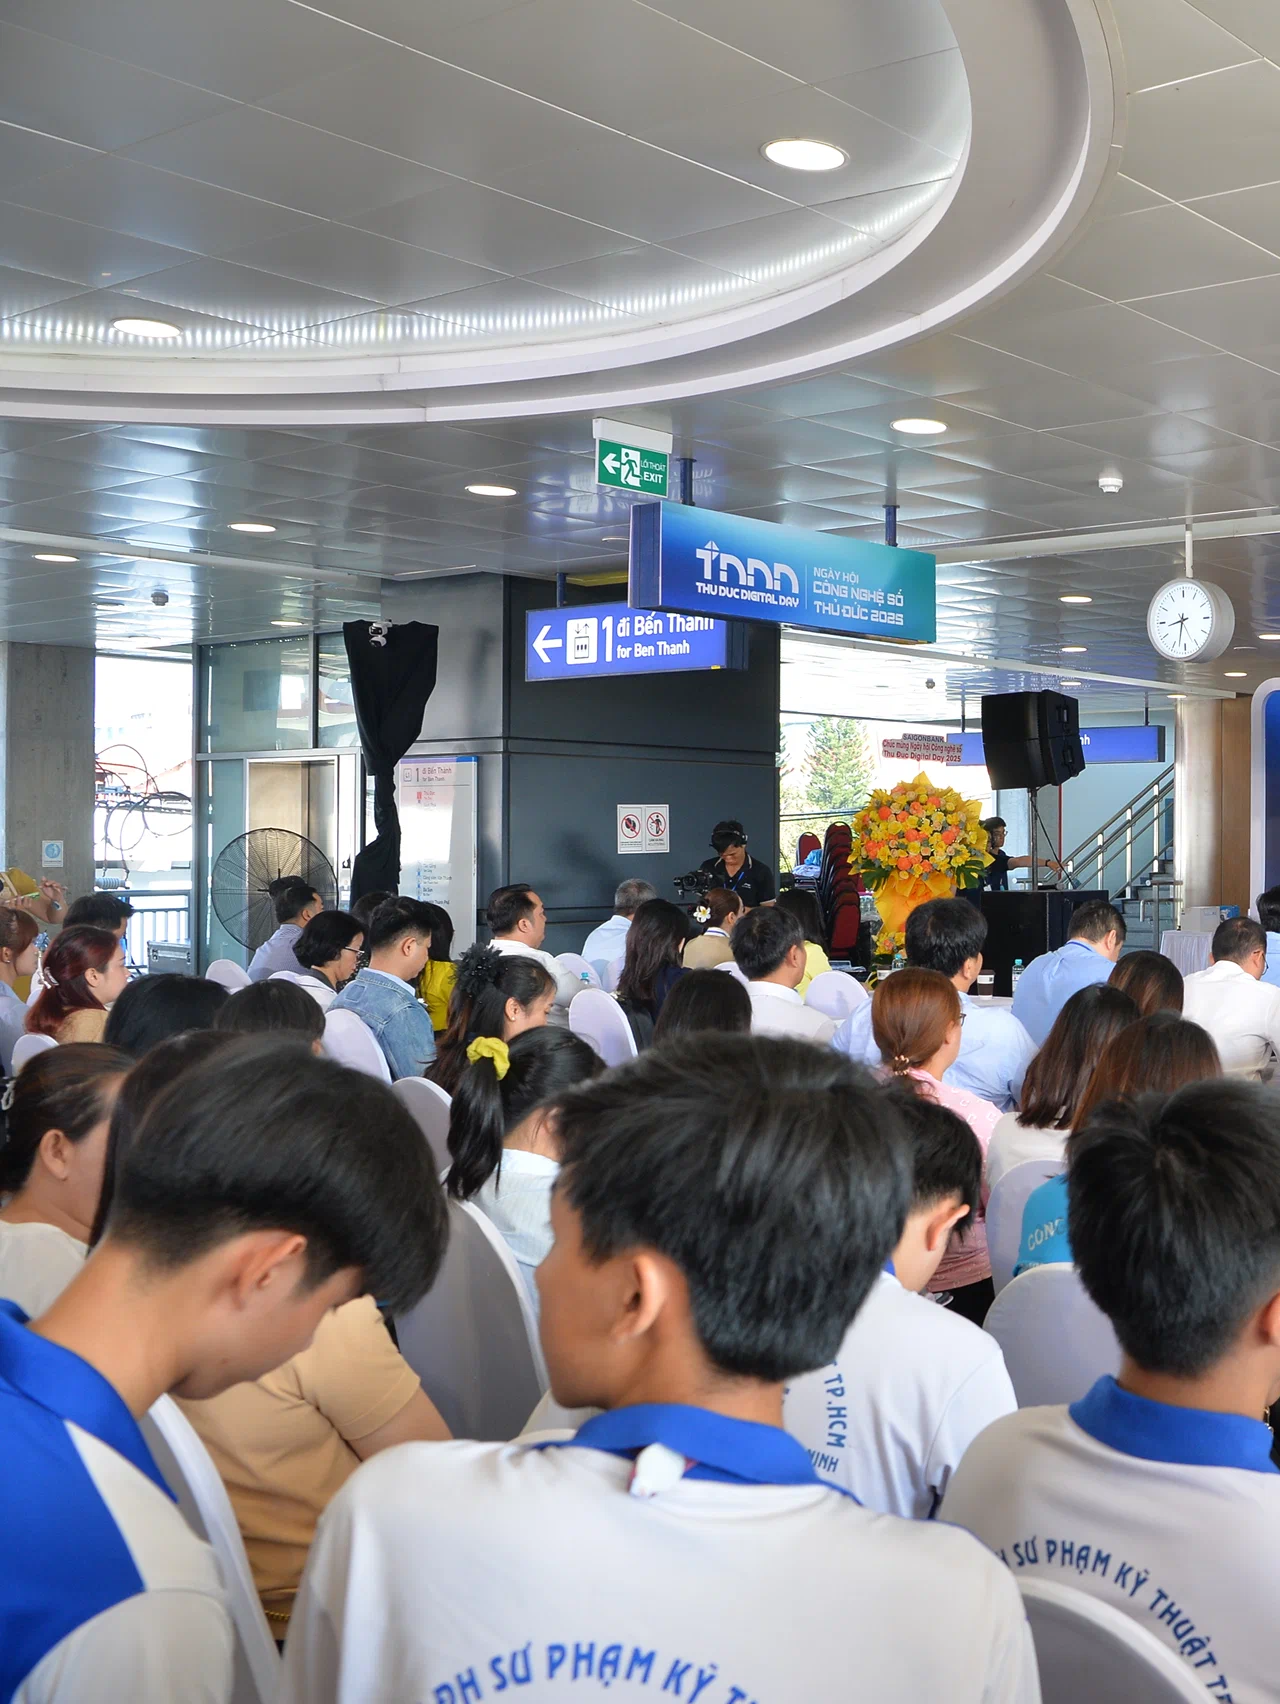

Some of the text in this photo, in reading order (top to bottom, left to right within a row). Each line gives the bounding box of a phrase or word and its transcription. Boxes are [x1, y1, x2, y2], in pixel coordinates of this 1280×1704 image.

[643, 471, 664, 484] EXIT
[813, 566, 859, 585] NGÀY HỘI
[695, 582, 800, 608] THU DUC DIGITAL DAY
[813, 578, 904, 607] CÔNG NGHỆ SỐ
[813, 598, 904, 626] THỦ ĐỨC 2025
[601, 616, 613, 663] 1
[617, 616, 630, 638] đi
[634, 611, 663, 636] Bến
[617, 639, 690, 659] for Ben Thanh
[903, 733, 945, 743] SAIGONBANK
[946, 755, 962, 763] 2025
[1045, 1538, 1112, 1577] PHẠM
[1148, 1588, 1218, 1669] THUẬT
[546, 1642, 657, 1689] PHẠM
